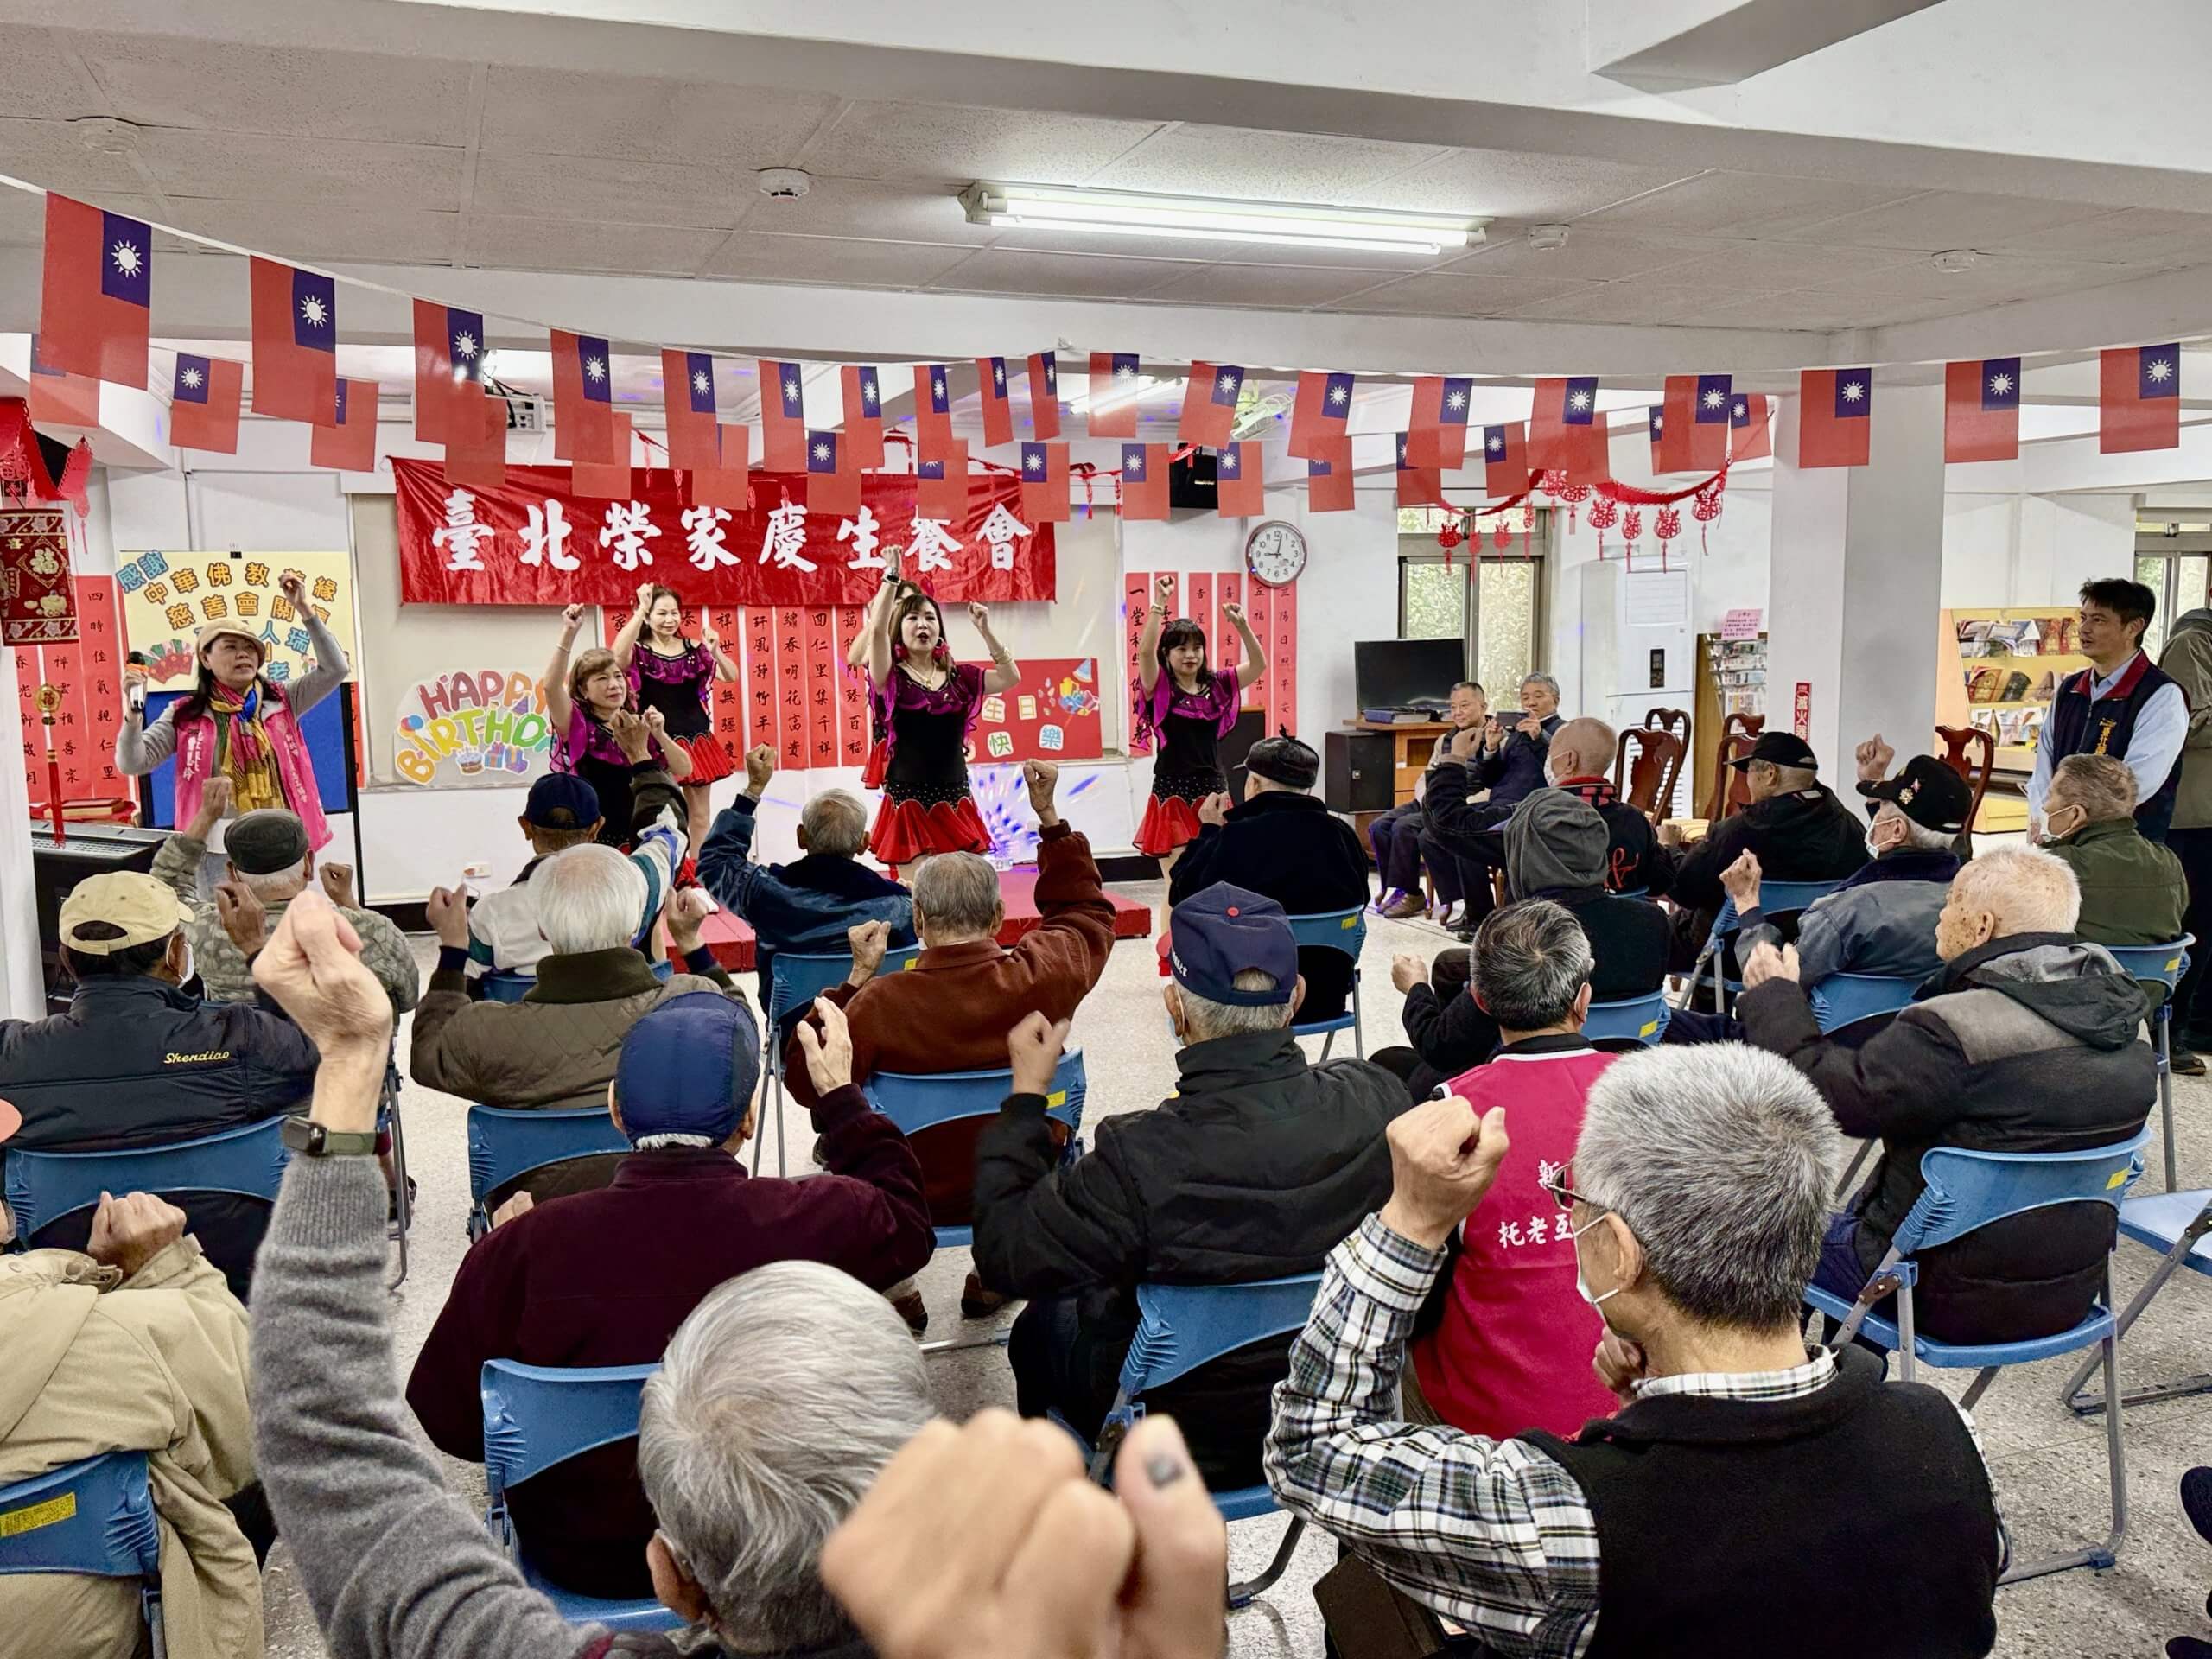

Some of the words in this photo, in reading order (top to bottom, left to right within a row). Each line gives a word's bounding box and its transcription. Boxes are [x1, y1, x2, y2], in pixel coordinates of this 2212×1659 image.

[116, 550, 169, 594] 感謝
[143, 562, 338, 605] 中華佛教緣
[988, 726, 1063, 756] 快樂
